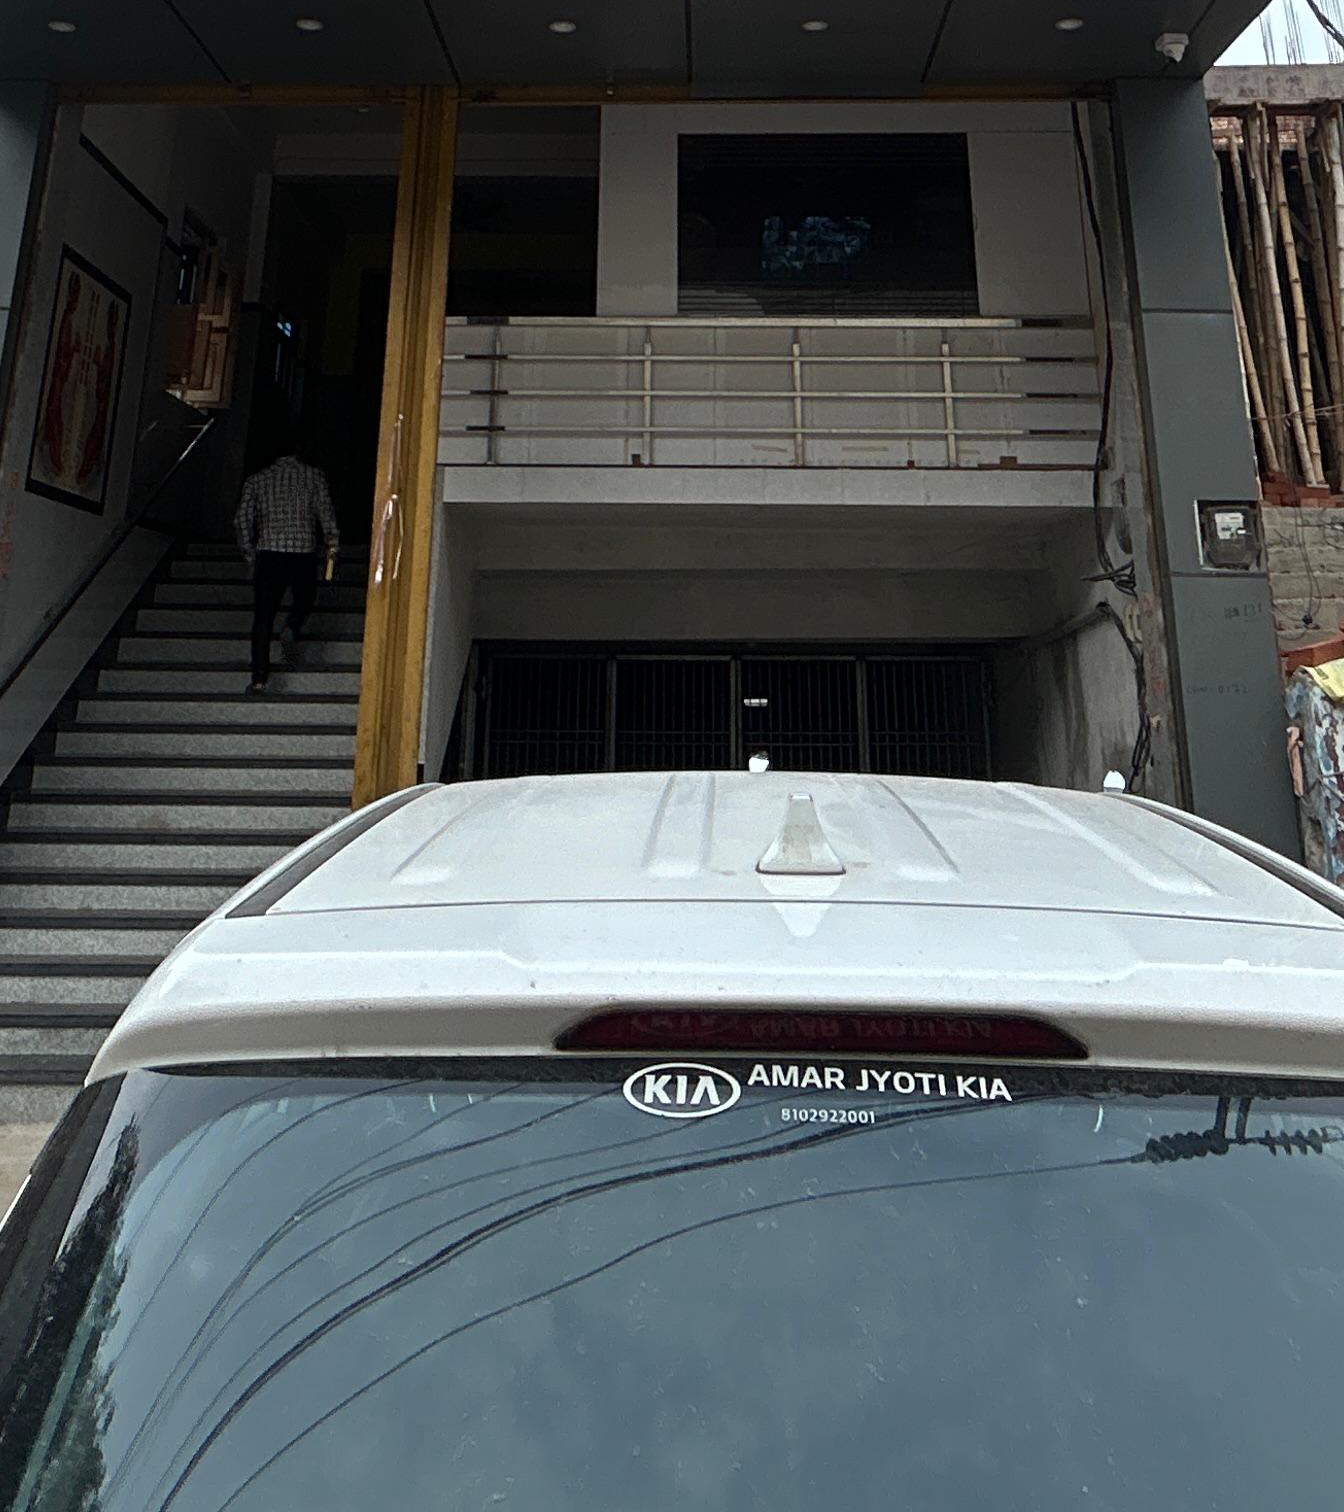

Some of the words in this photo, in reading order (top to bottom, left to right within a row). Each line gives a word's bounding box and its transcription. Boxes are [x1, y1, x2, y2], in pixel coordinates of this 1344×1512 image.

[644, 1074, 721, 1105] KIA
[747, 1064, 846, 1090] AMAR
[856, 1068, 946, 1096] JYOTI
[957, 1075, 1013, 1101] KIA
[781, 1107, 875, 1124] 8102922001
